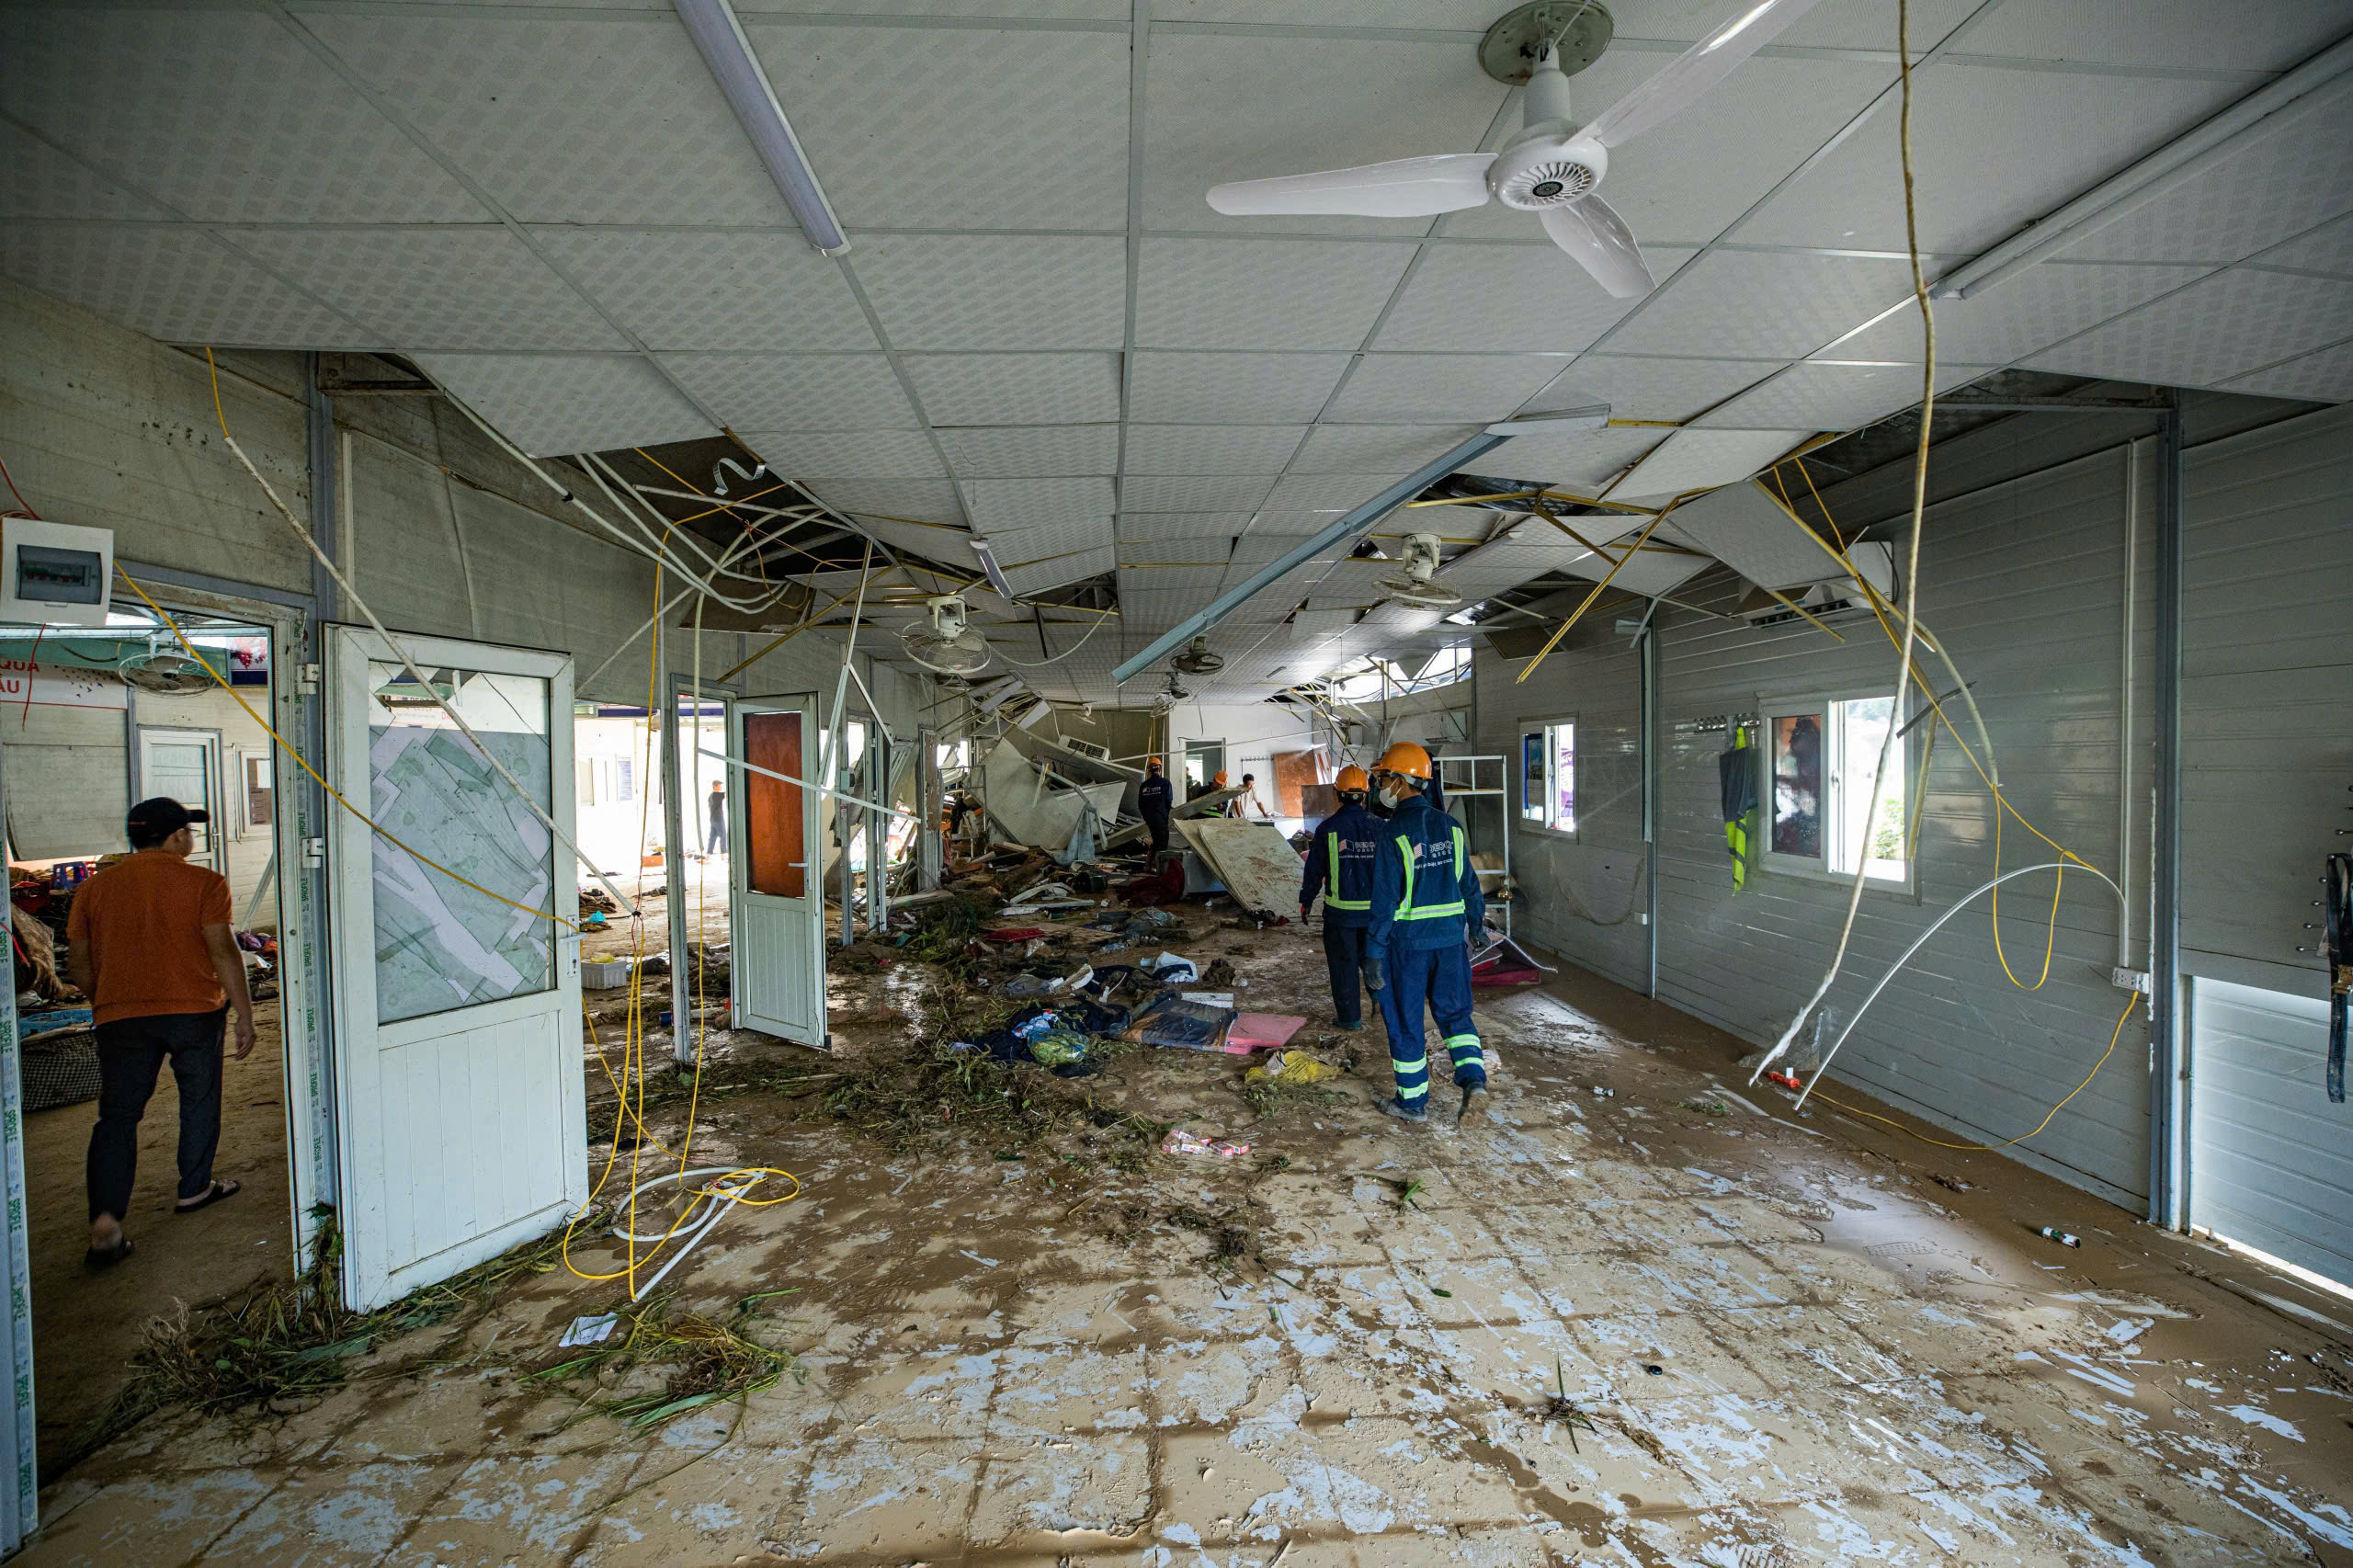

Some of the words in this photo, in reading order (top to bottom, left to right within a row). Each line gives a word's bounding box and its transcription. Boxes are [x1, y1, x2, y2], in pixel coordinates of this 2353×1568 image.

[298, 812, 306, 836] SPROFILE
[301, 877, 309, 902] SPROFILE
[303, 942, 312, 967] SPROFILE
[306, 1007, 314, 1032] SPROFILE
[0, 1020, 12, 1054] SPROFILE
[4, 1109, 17, 1143] SPROFILE
